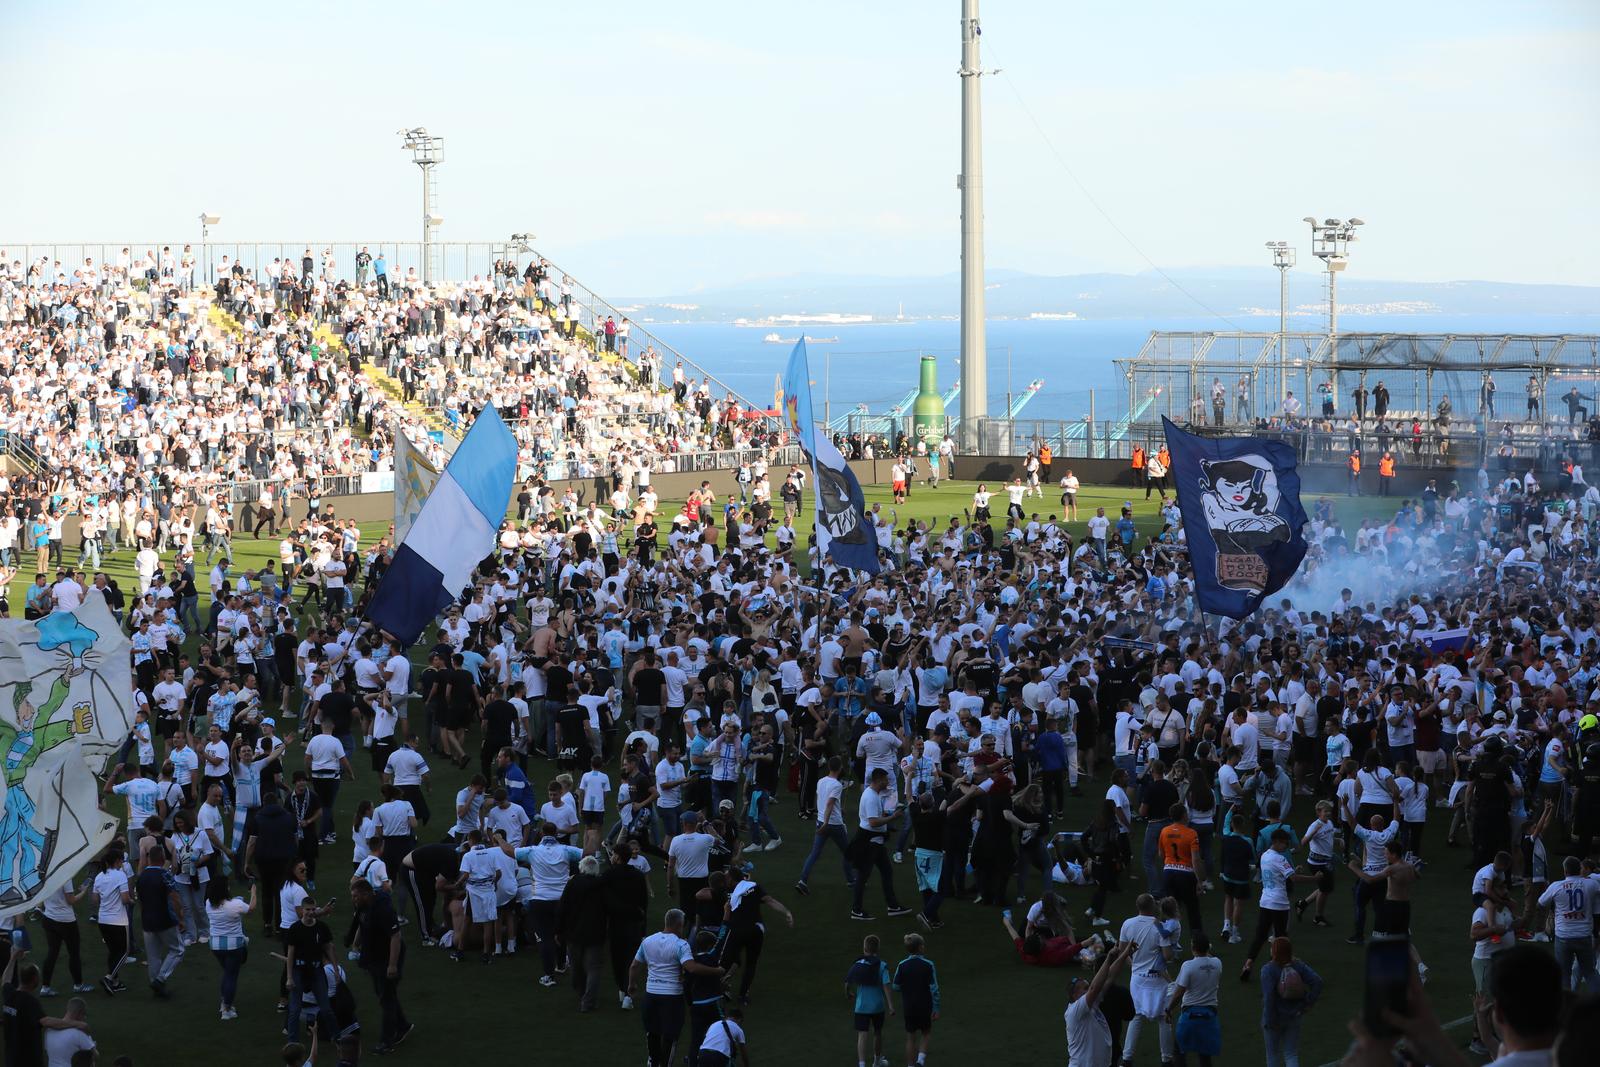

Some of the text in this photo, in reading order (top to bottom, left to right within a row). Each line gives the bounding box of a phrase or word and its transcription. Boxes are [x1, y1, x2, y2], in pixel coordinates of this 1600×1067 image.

[916, 423, 945, 438] Carlsbe
[919, 857, 931, 873] 4
[1566, 889, 1584, 911] 10
